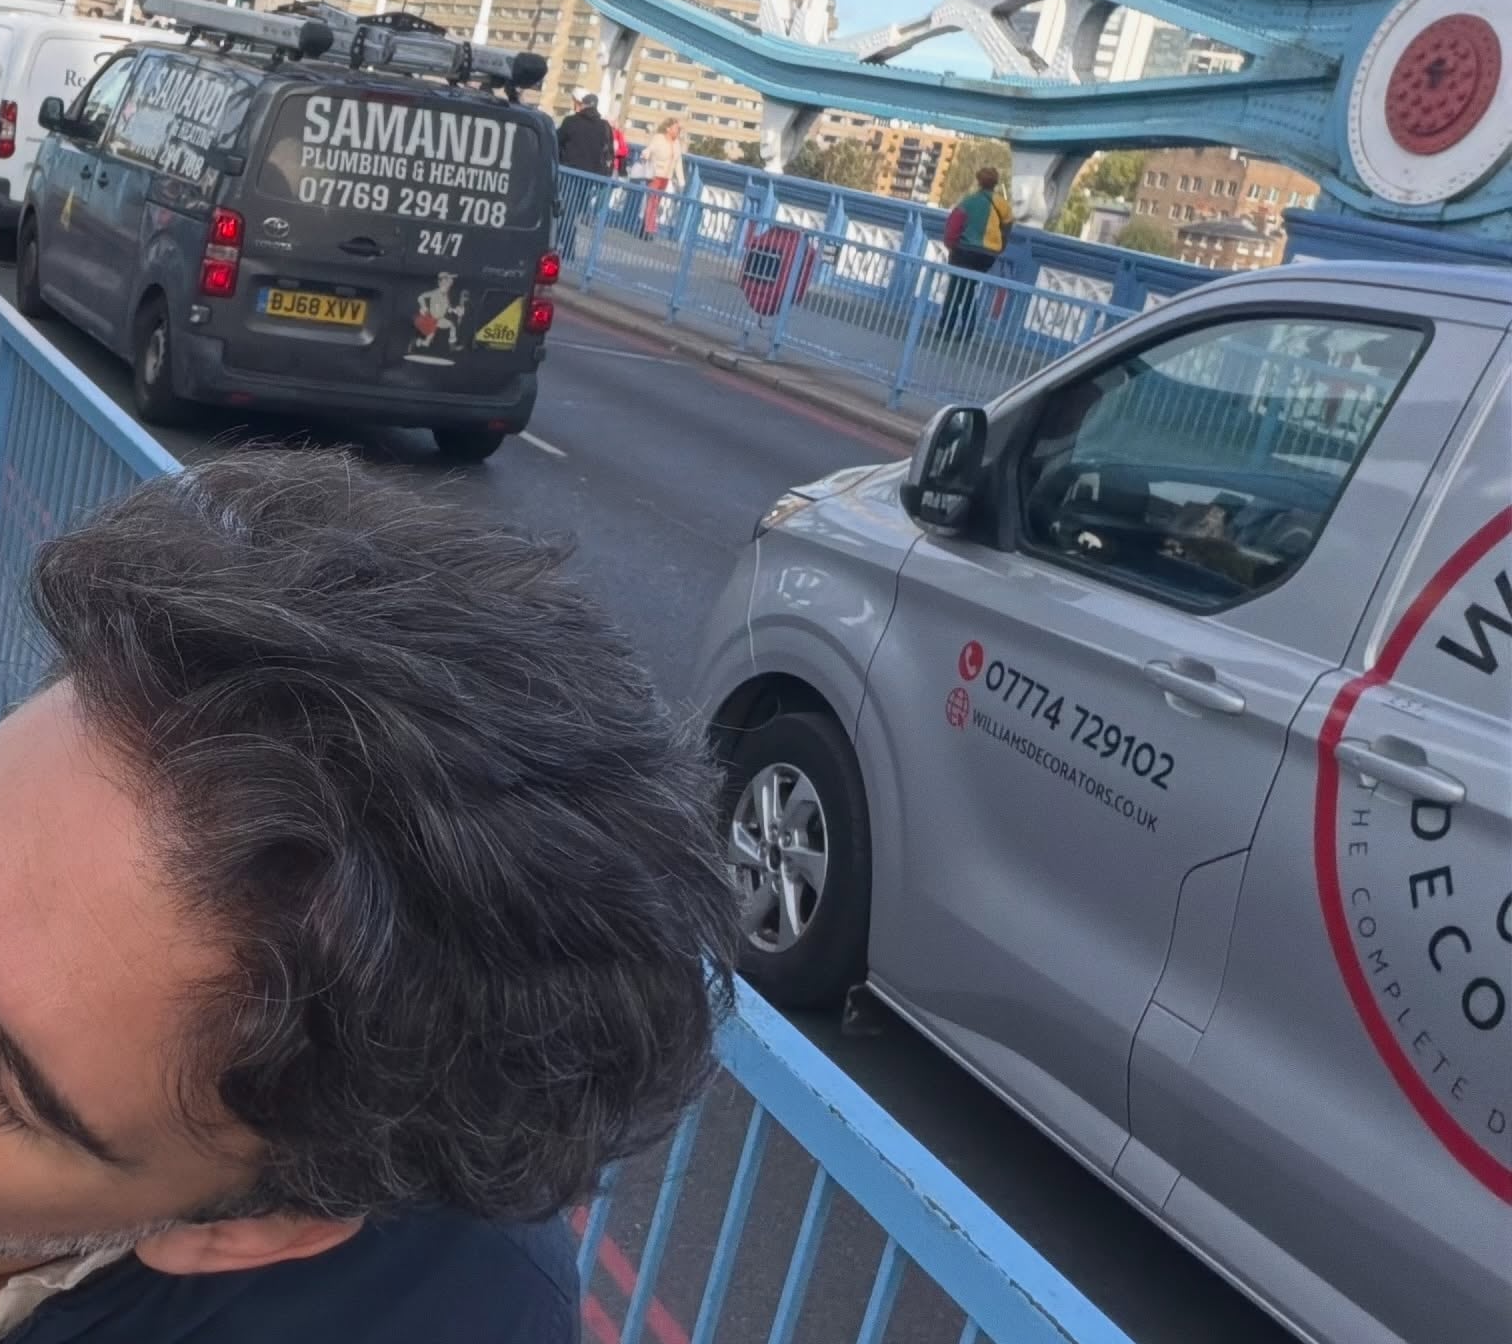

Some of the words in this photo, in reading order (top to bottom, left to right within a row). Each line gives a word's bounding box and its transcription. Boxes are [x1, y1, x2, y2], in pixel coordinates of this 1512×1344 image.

[148, 66, 233, 127] SAMANDI
[303, 95, 517, 170] SAMANDI
[301, 145, 407, 180] PLUMBING
[412, 159, 425, 183] &
[429, 163, 510, 195] HEATING
[298, 176, 389, 211] 07769
[398, 188, 449, 220] 294
[459, 196, 508, 229] 708
[417, 229, 464, 257] 24/7
[270, 288, 319, 315] BJ68
[324, 297, 361, 320] XVV
[483, 325, 515, 341] safe
[985, 660, 1065, 731] 07774
[1070, 703, 1175, 791] 729102
[972, 708, 1159, 833] WILLIAMSDECORATORS.CO.UK
[1410, 799, 1506, 1031] DECO
[1351, 887, 1471, 1101] COMPLETE
